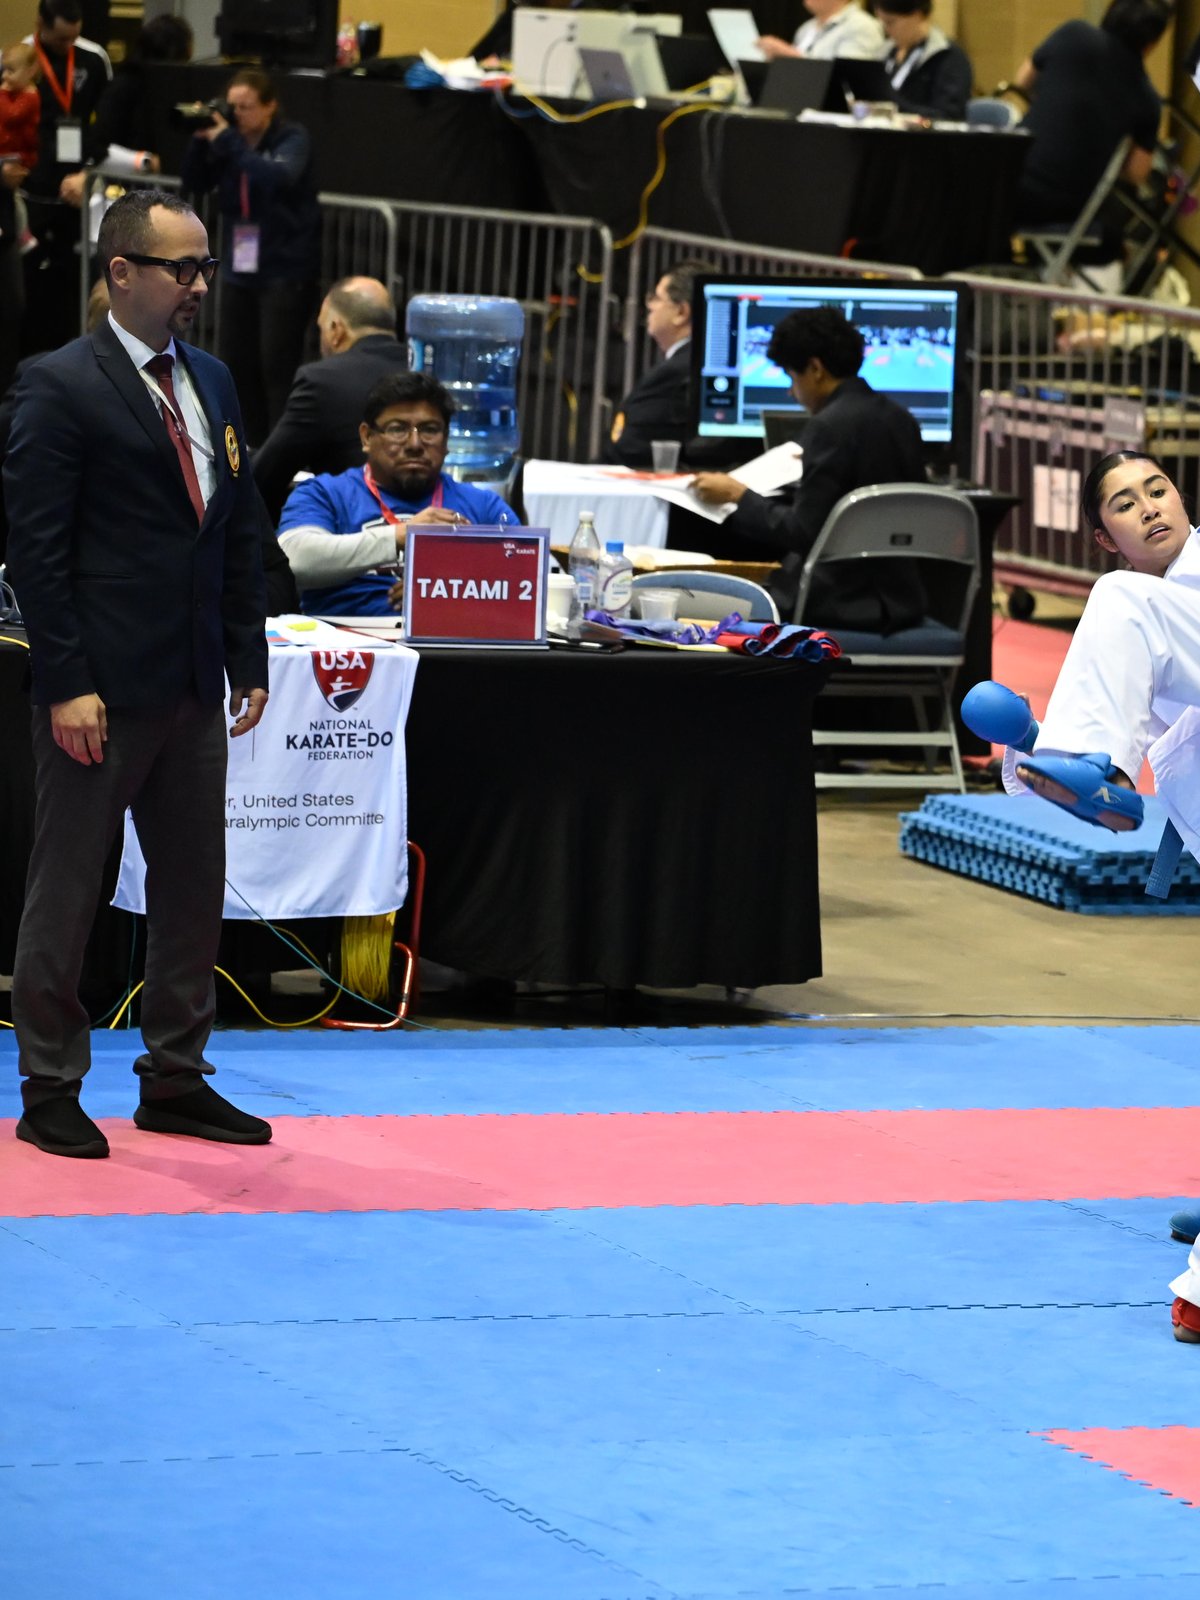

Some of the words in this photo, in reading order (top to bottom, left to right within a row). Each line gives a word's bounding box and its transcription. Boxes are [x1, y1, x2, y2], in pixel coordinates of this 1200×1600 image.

[417, 578, 508, 600] TATAMI
[518, 580, 532, 600] 2
[320, 651, 366, 670] USA
[309, 720, 374, 731] NATIONAL
[286, 731, 393, 750] KARATE-DO
[307, 751, 374, 761] FEDERATION
[243, 794, 297, 808] United
[302, 793, 354, 808] States
[305, 812, 384, 828] Committe
